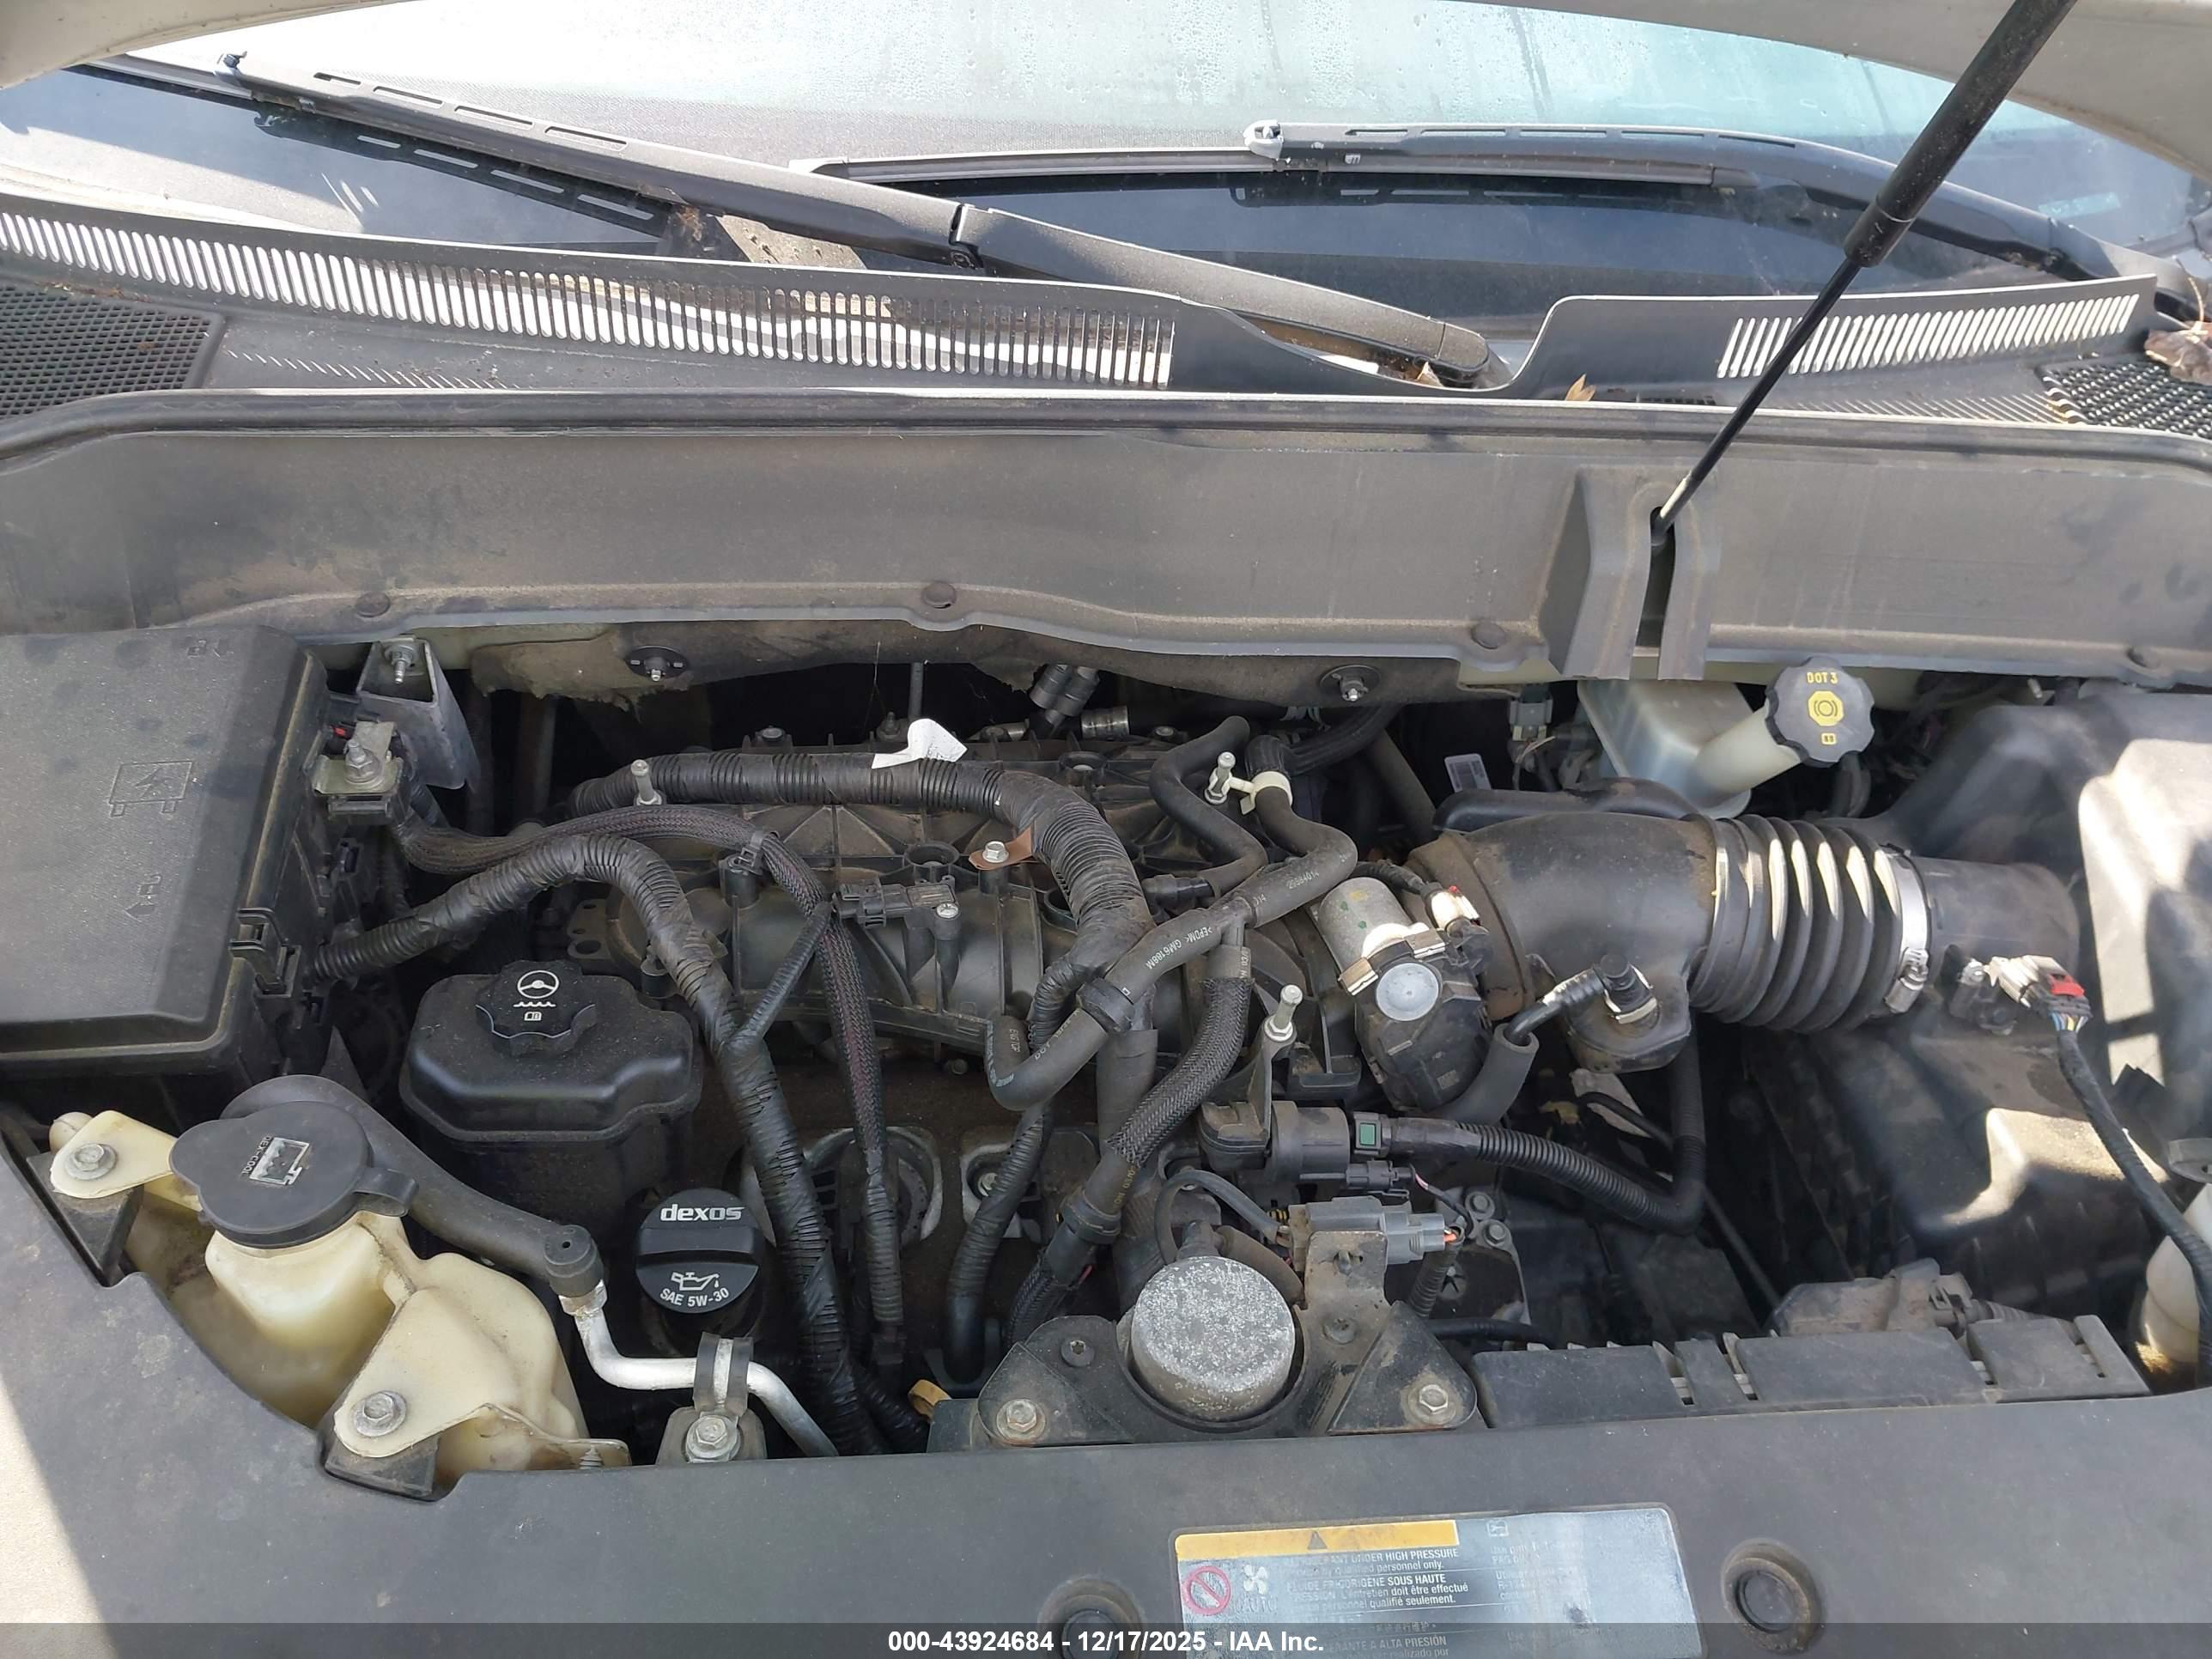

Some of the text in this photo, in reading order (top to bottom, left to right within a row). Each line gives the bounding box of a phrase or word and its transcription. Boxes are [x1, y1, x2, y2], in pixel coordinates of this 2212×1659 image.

[1807, 672, 1838, 684] DOT 3
[241, 1135, 272, 1176] DEX-COOL
[660, 1204, 744, 1221] dexos
[659, 1287, 729, 1307] SAE 5W-30
[1385, 1550, 1409, 1562] HIGH
[1410, 1547, 1459, 1560] PRESSURE
[1387, 1575, 1413, 1586] SOUS
[1414, 1573, 1447, 1585] HAUTE
[1391, 1585, 1409, 1597] doit
[1411, 1584, 1430, 1595] être
[1431, 1581, 1469, 1595] effectué
[1369, 1595, 1404, 1611] qualifié
[1405, 1594, 1457, 1607] seulement.
[1380, 1638, 1403, 1650] ALTA
[1404, 1634, 1447, 1648] PRESIÓN
